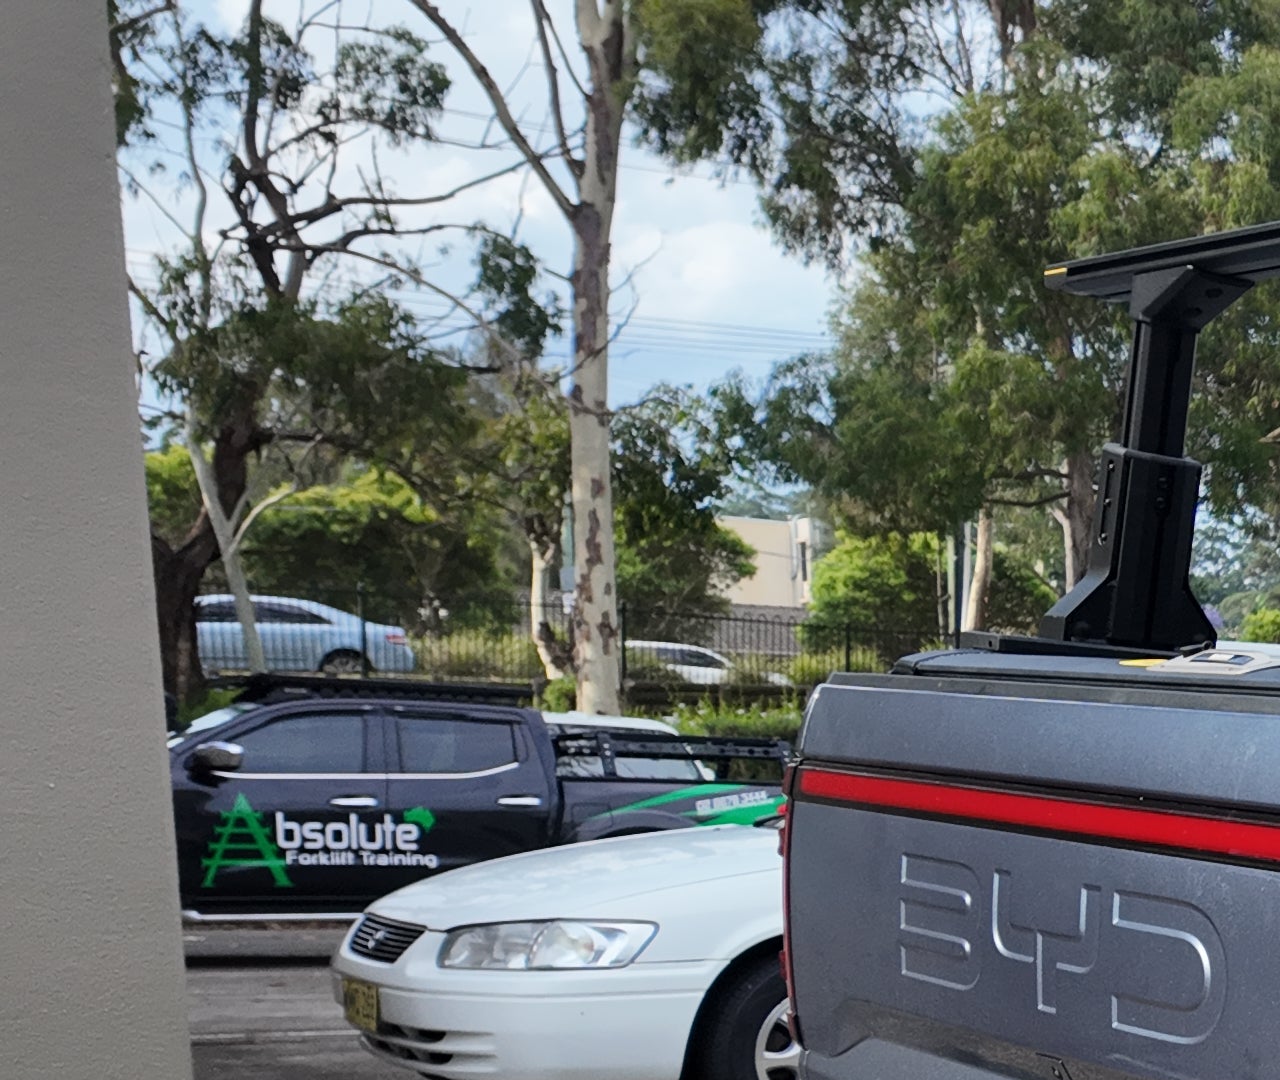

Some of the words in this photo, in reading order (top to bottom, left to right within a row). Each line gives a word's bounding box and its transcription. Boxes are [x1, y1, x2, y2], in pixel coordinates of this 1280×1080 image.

[285, 850, 354, 867] Forklift
[360, 850, 439, 869] Training
[899, 852, 1228, 1044] BYD
